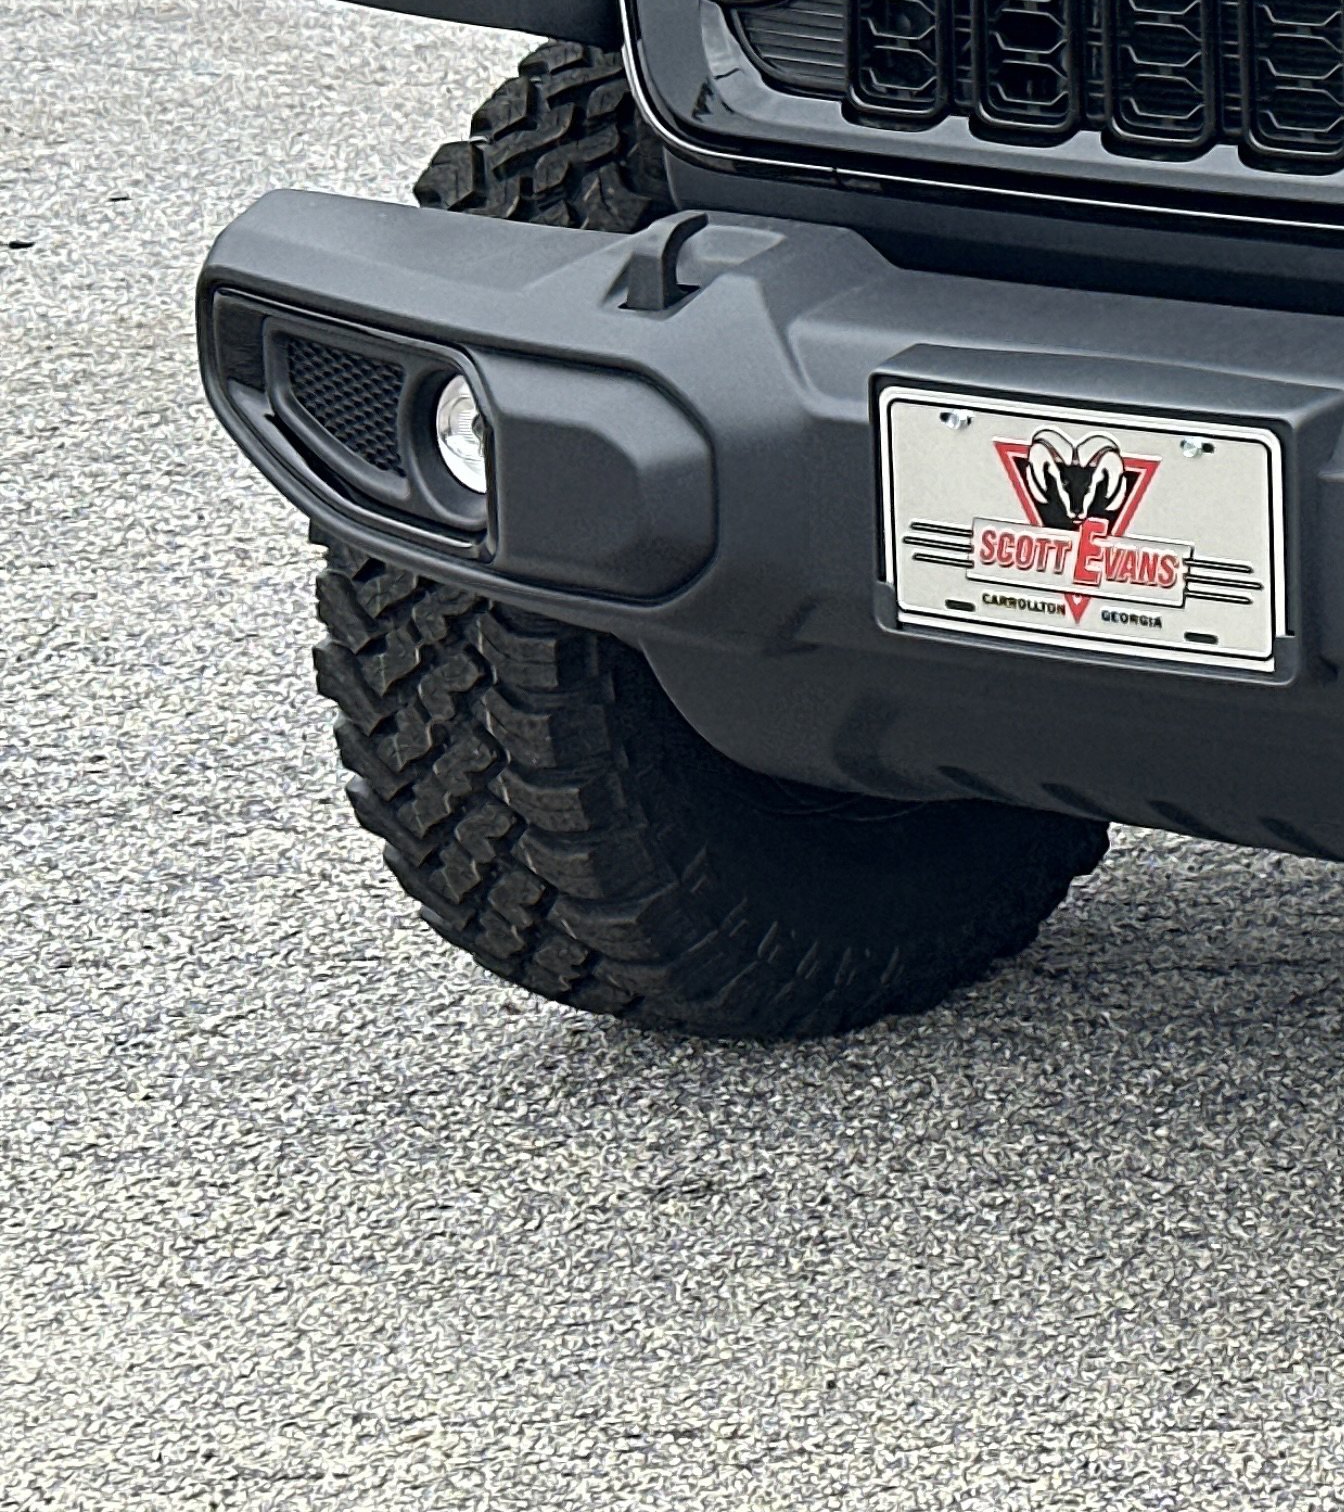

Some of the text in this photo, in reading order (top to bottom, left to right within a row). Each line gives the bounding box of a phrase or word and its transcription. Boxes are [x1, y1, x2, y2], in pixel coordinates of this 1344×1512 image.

[979, 518, 1180, 588] SCOTT EVANS
[982, 592, 1163, 630] CARROLLTON GEORGIA
